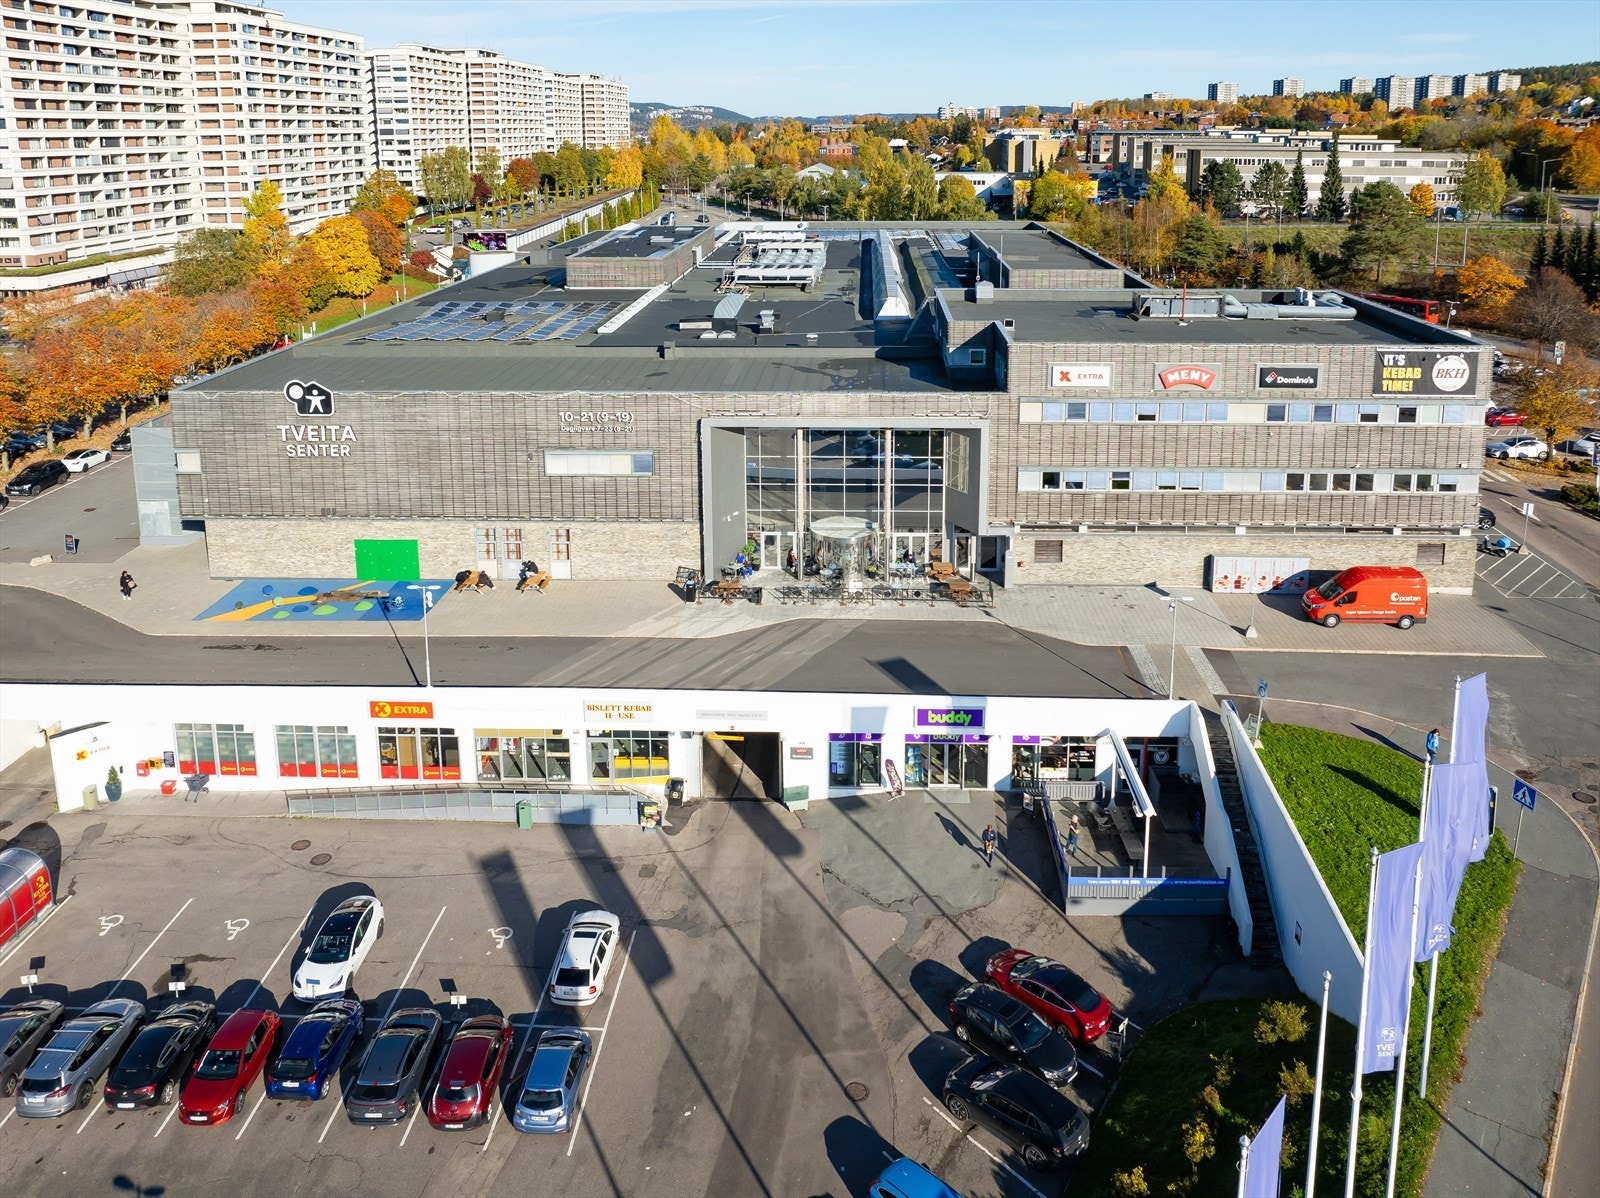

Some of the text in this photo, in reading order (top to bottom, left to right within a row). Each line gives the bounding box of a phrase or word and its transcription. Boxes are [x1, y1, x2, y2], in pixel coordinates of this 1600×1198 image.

[1383, 354, 1406, 366] IT'S
[1166, 369, 1211, 383] MENY
[1382, 367, 1422, 378] KEBAB
[1434, 368, 1467, 379] BKH
[1276, 375, 1315, 384] Domino's
[1382, 380, 1414, 392] TIME!
[276, 425, 358, 442] TVEITA
[286, 445, 352, 457] SENTER
[393, 706, 428, 714] EXTRA
[927, 711, 972, 726] buddy
